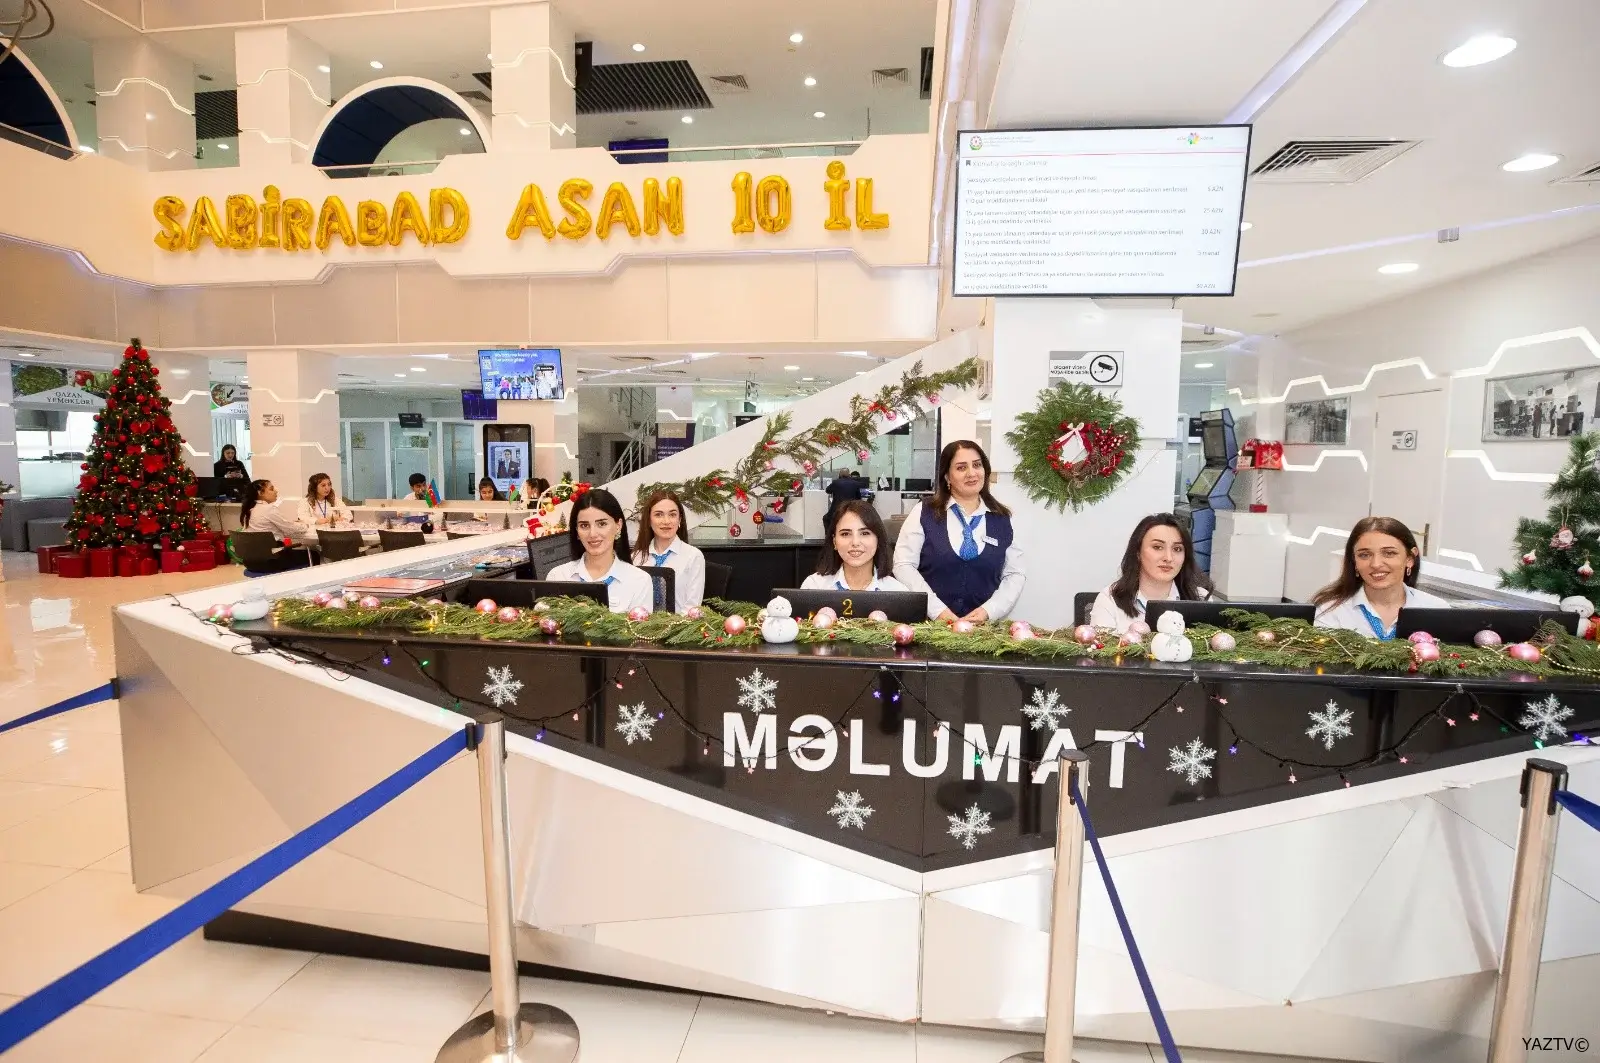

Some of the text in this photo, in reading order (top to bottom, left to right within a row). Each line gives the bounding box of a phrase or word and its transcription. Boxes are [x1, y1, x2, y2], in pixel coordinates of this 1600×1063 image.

[153, 160, 890, 252] SABİRABAD ASAN 10 İL
[55, 391, 83, 399] QAZAN
[842, 598, 853, 616] 2
[722, 711, 1144, 789] MƏLUMAT
